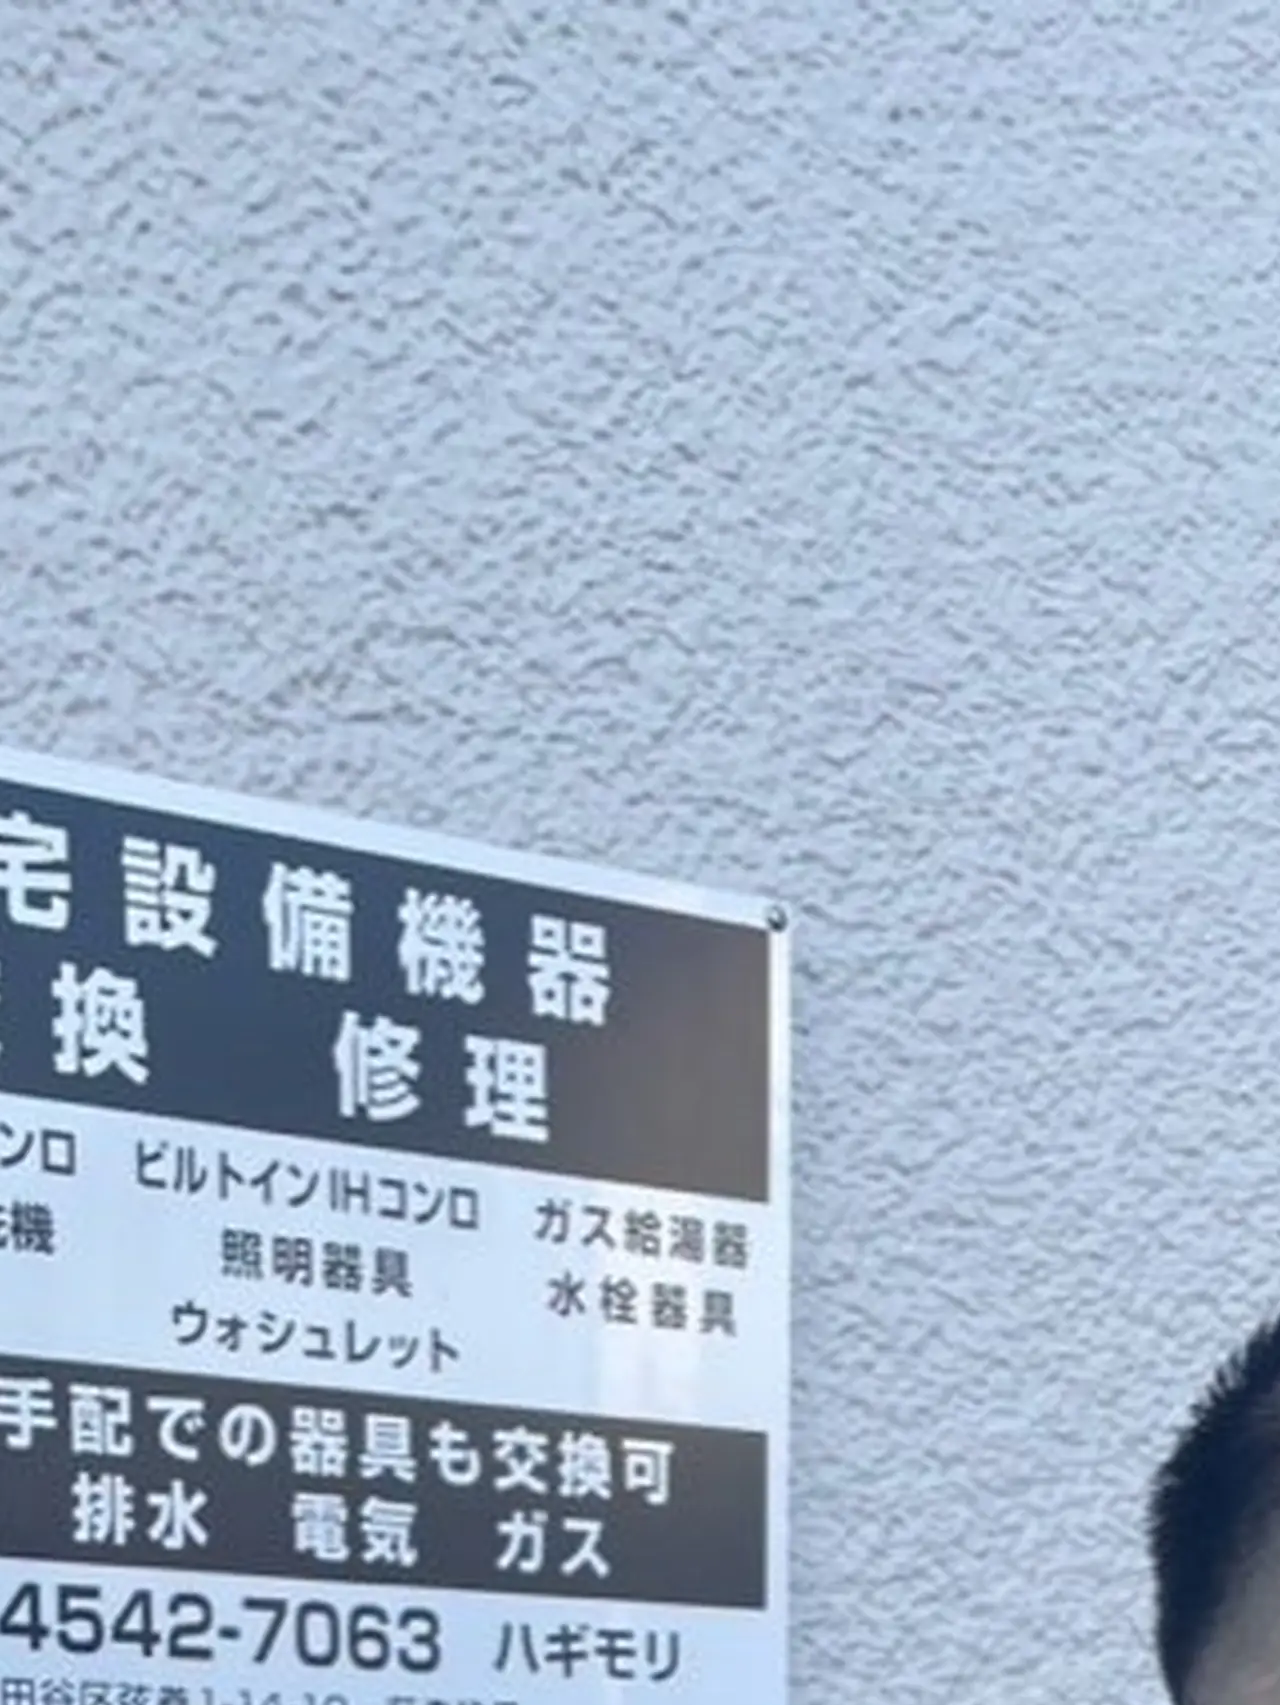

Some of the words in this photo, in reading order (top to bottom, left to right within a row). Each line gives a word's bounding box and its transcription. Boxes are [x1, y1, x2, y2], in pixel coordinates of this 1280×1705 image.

[332, 1012, 550, 1143] 修理
[135, 1141, 480, 1231] ビルトインIHコンロ
[535, 1200, 750, 1270] ガス給湯器
[220, 1228, 414, 1298] 照明器具
[547, 1272, 737, 1337] 水栓器具
[171, 1301, 460, 1373] ウォシュレット
[72, 1475, 209, 1550] 排水
[292, 1494, 419, 1569] 電気
[496, 1514, 611, 1579] ガス
[493, 1619, 682, 1681] ハギモリ
